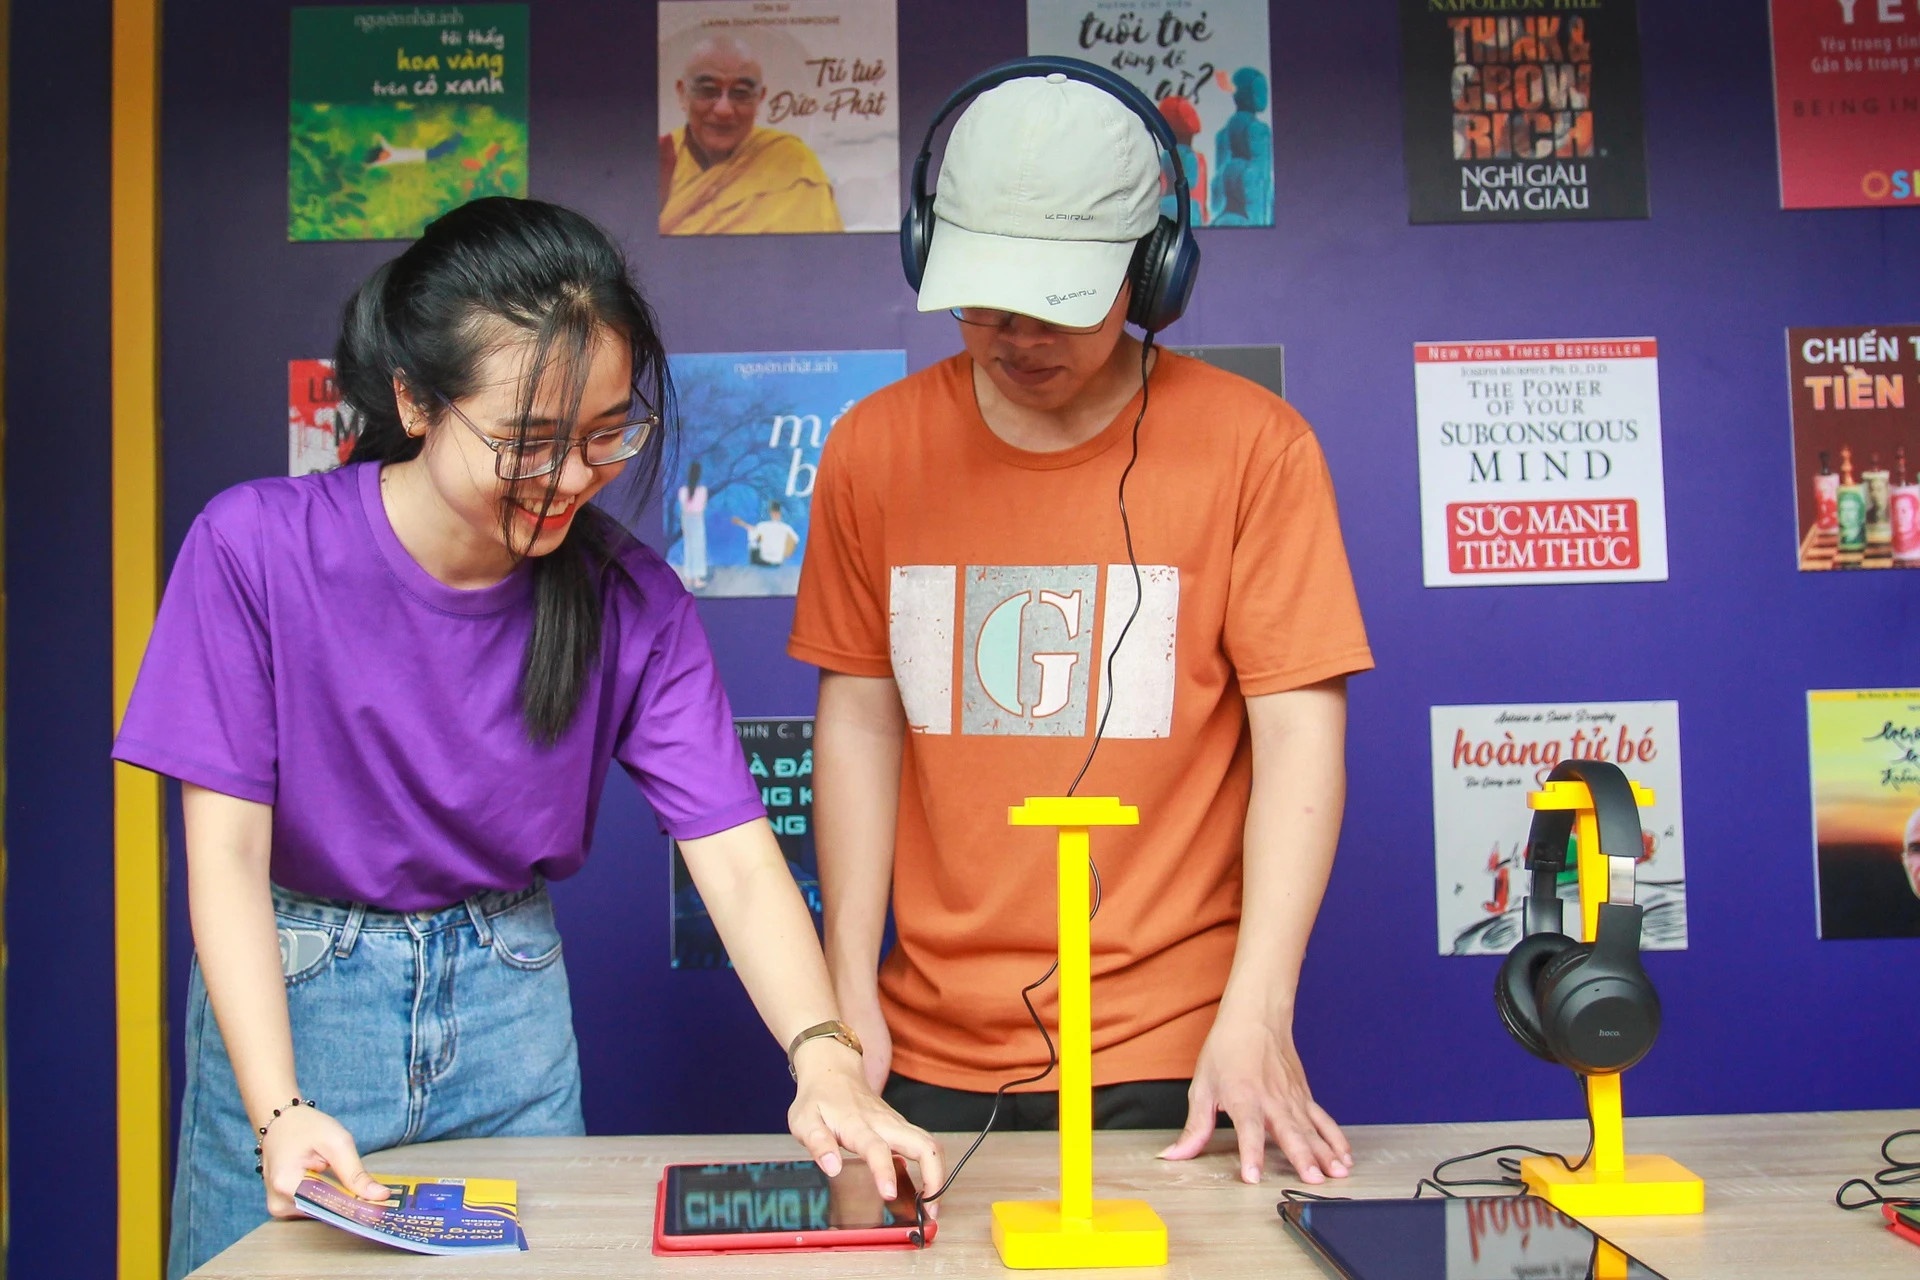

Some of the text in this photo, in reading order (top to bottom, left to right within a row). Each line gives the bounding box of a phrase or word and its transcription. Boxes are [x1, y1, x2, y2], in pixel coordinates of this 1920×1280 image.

[1157, 9, 1214, 48] trẻ
[1447, 16, 1563, 63] THINK
[397, 47, 504, 78] hoa vàng
[413, 73, 438, 96] cỏ
[444, 70, 504, 95] xanh
[1452, 63, 1592, 112] GROW
[1793, 98, 1880, 117] BEING
[1452, 111, 1594, 160] RICH
[1045, 213, 1094, 221] KAIRUI
[1058, 288, 1097, 301] KAIRUI
[1428, 343, 1642, 360] NEW YORK TIMES BESTSELLER
[1802, 329, 1899, 364] CHIẾN
[1468, 378, 1603, 399] THE POWER
[1804, 365, 1905, 411] TIỀN
[1486, 399, 1585, 417] OF YOUR
[1440, 419, 1639, 446] SUBCONSCIOUS
[1468, 449, 1613, 484] MIND
[1526, 503, 1629, 536] MẠNH
[975, 589, 1082, 718] G
[1453, 728, 1561, 790] hoàng
[1616, 724, 1658, 765] bé
